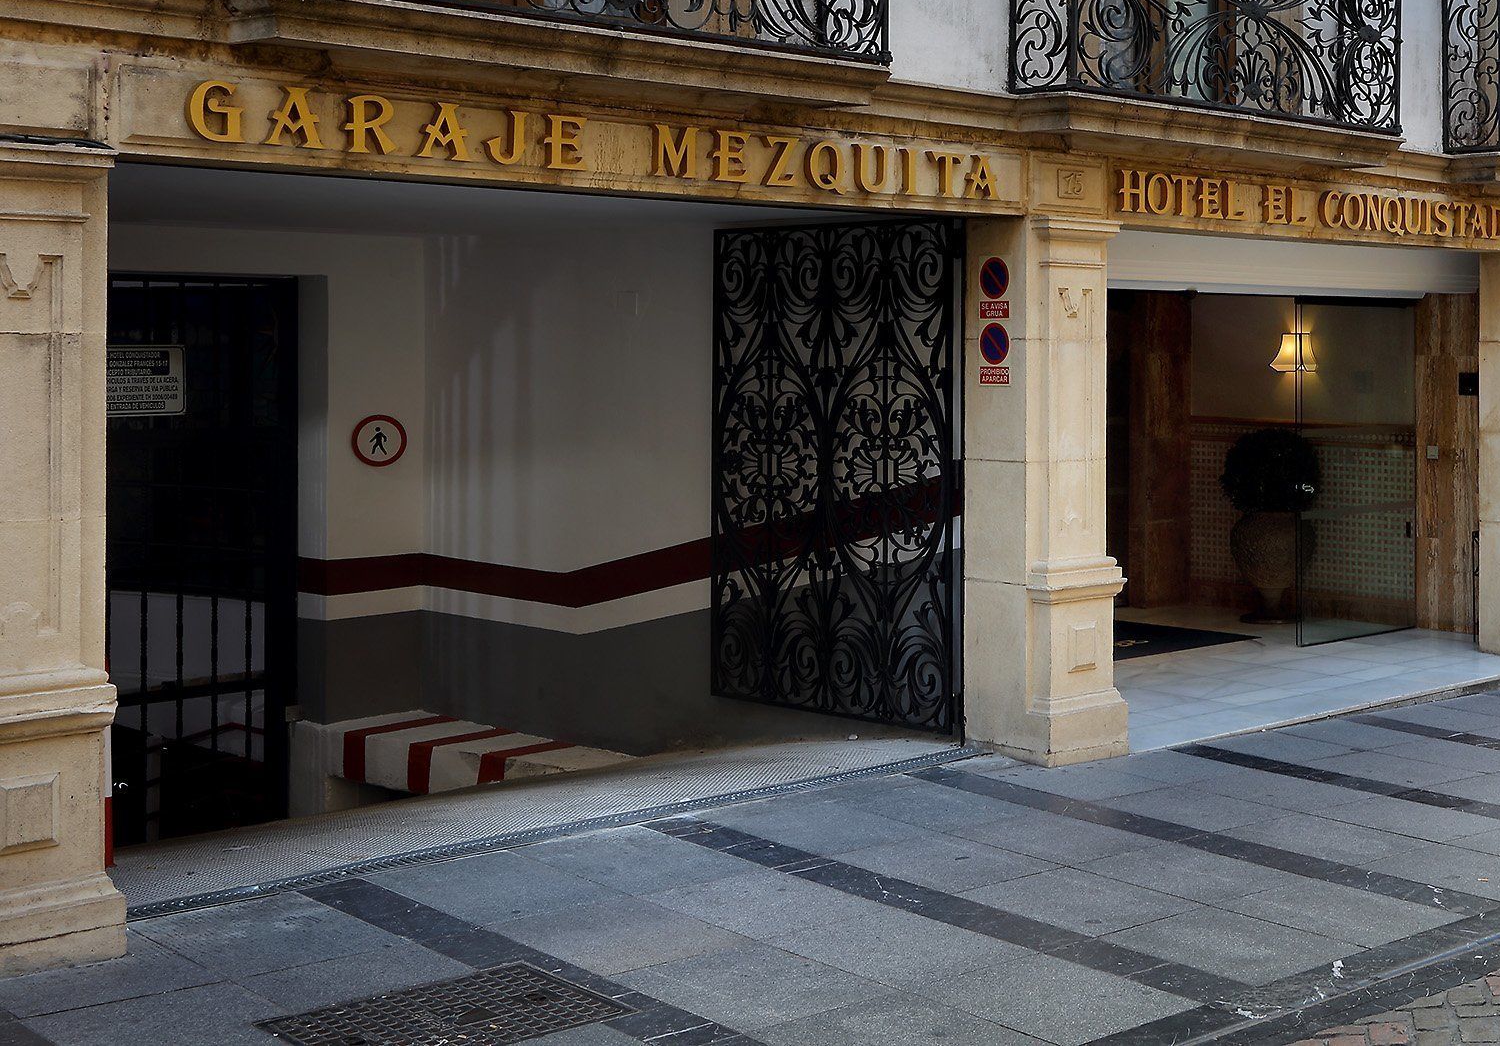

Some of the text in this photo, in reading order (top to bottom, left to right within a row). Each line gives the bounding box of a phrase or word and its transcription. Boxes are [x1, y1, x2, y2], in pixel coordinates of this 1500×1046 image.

[186, 80, 1000, 200] GARAJE MEZQUITA
[1063, 172, 1084, 195] 15
[1118, 169, 1248, 220] HOTEL
[1263, 185, 1308, 225] EL
[981, 302, 1008, 310] SE AVISA
[109, 351, 125, 359] HOTEL
[125, 351, 161, 359] CONQUISTADOR
[981, 375, 1008, 383] APARCAR
